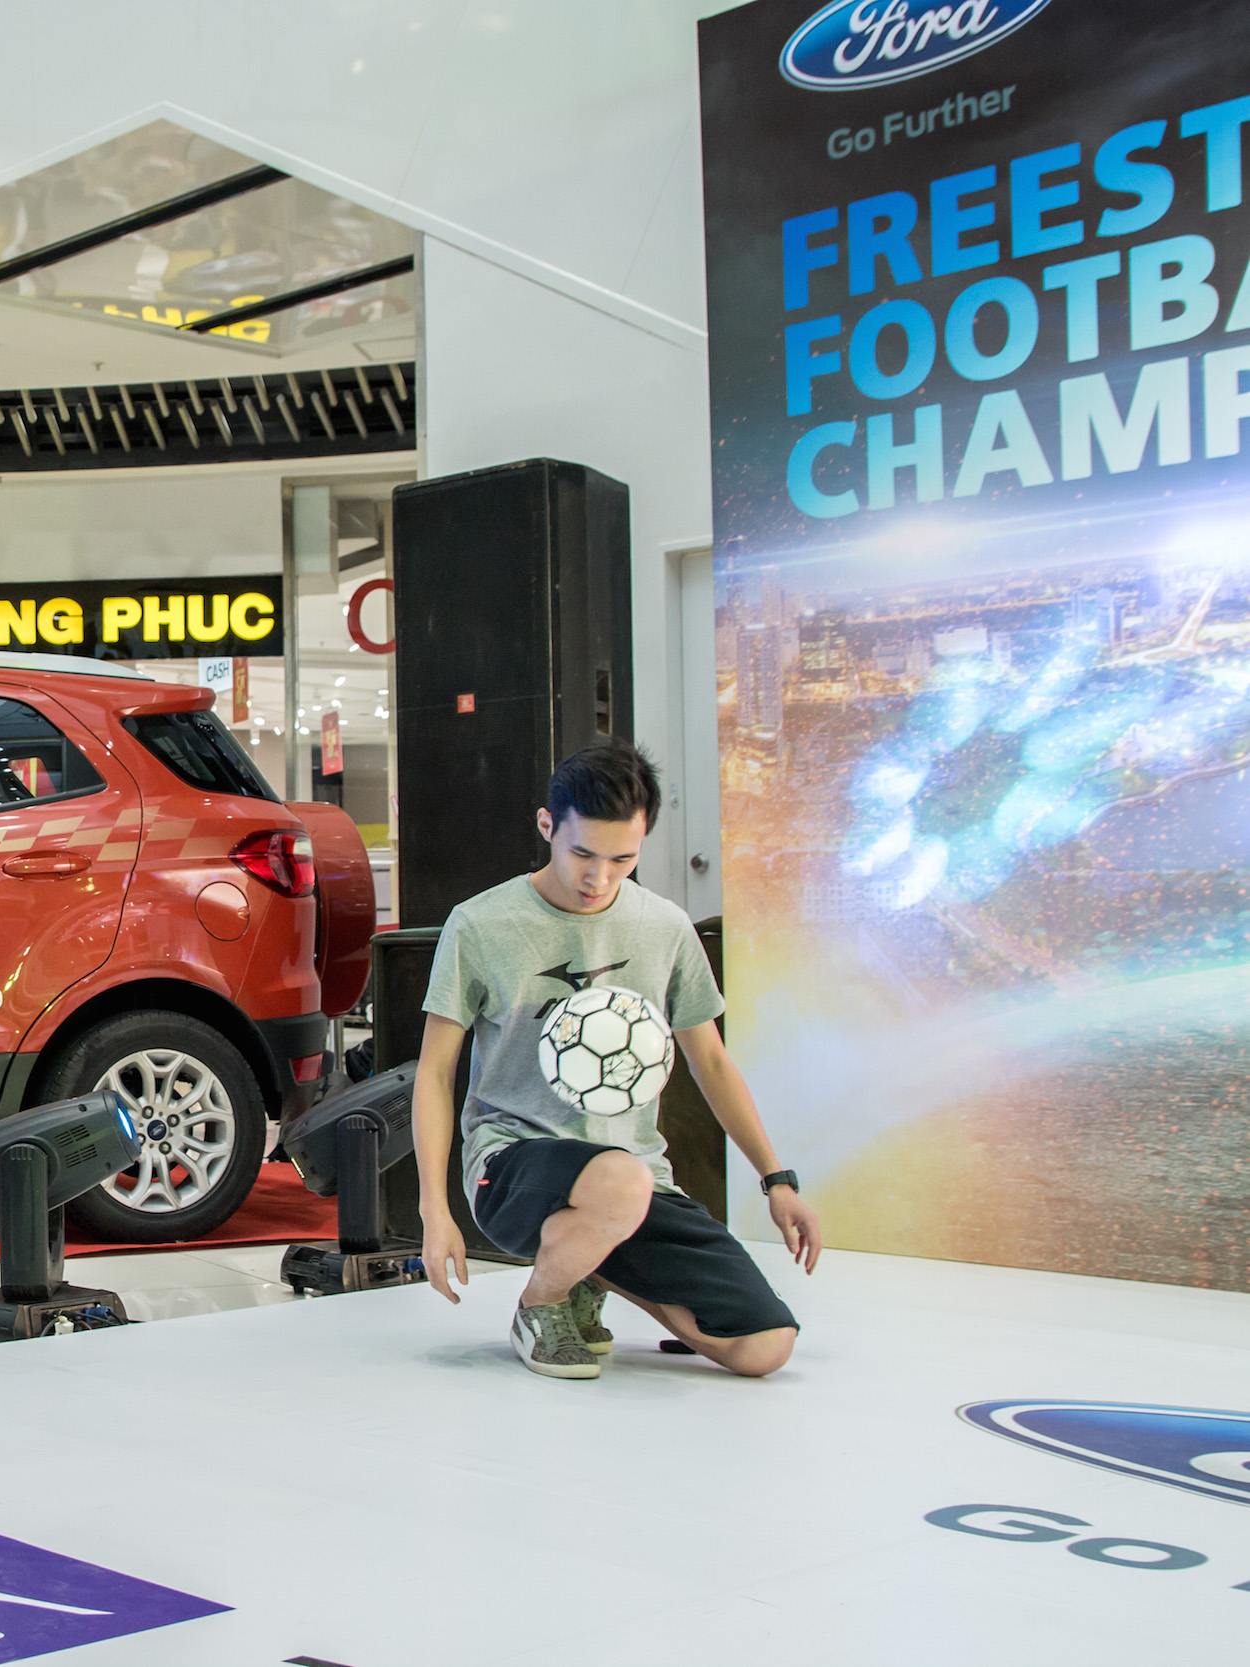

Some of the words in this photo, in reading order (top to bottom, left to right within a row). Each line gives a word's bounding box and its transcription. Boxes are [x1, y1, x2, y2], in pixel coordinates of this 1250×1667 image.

[833, 0, 999, 74] Ford
[827, 127, 876, 159] Go
[882, 84, 1016, 145] Further
[782, 93, 1250, 312] FREEST
[102, 592, 275, 643] PHUC
[206, 660, 230, 683] CASH
[923, 1503, 1209, 1571] Go
